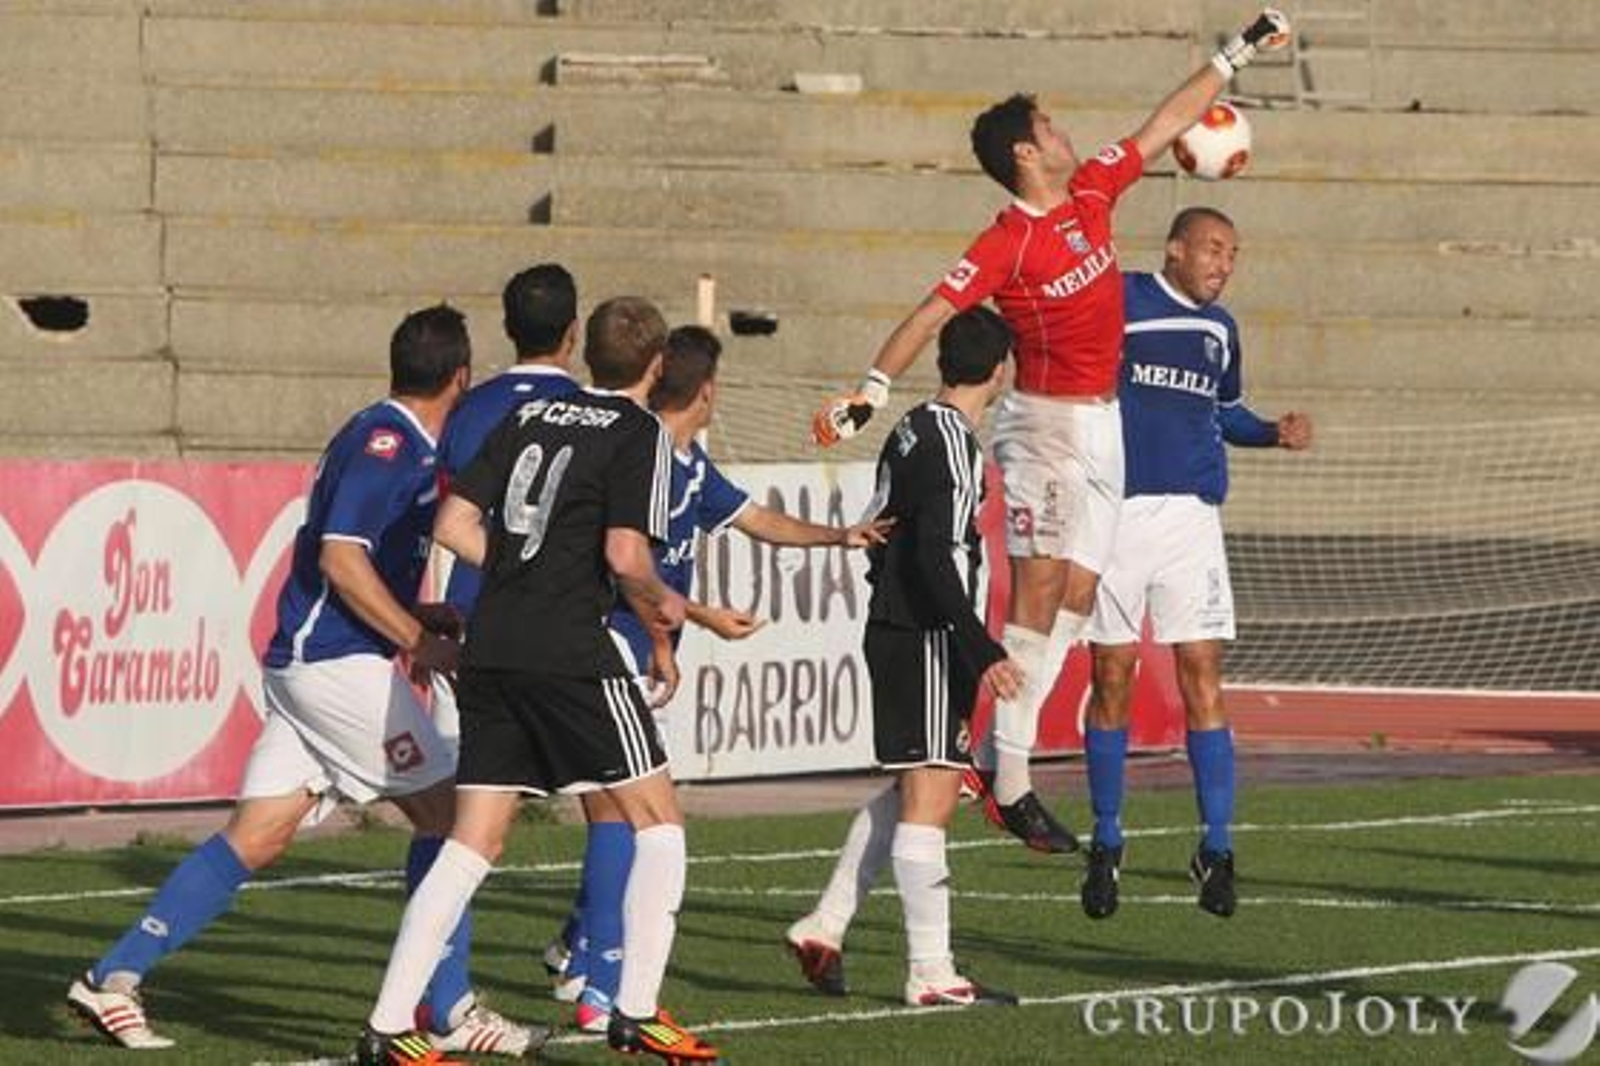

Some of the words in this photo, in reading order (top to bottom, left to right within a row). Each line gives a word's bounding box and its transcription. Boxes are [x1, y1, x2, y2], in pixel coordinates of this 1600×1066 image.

[504, 443, 573, 560] 4
[104, 506, 173, 638] Don
[54, 607, 221, 713] Caramelo
[695, 654, 858, 754] BARRIO
